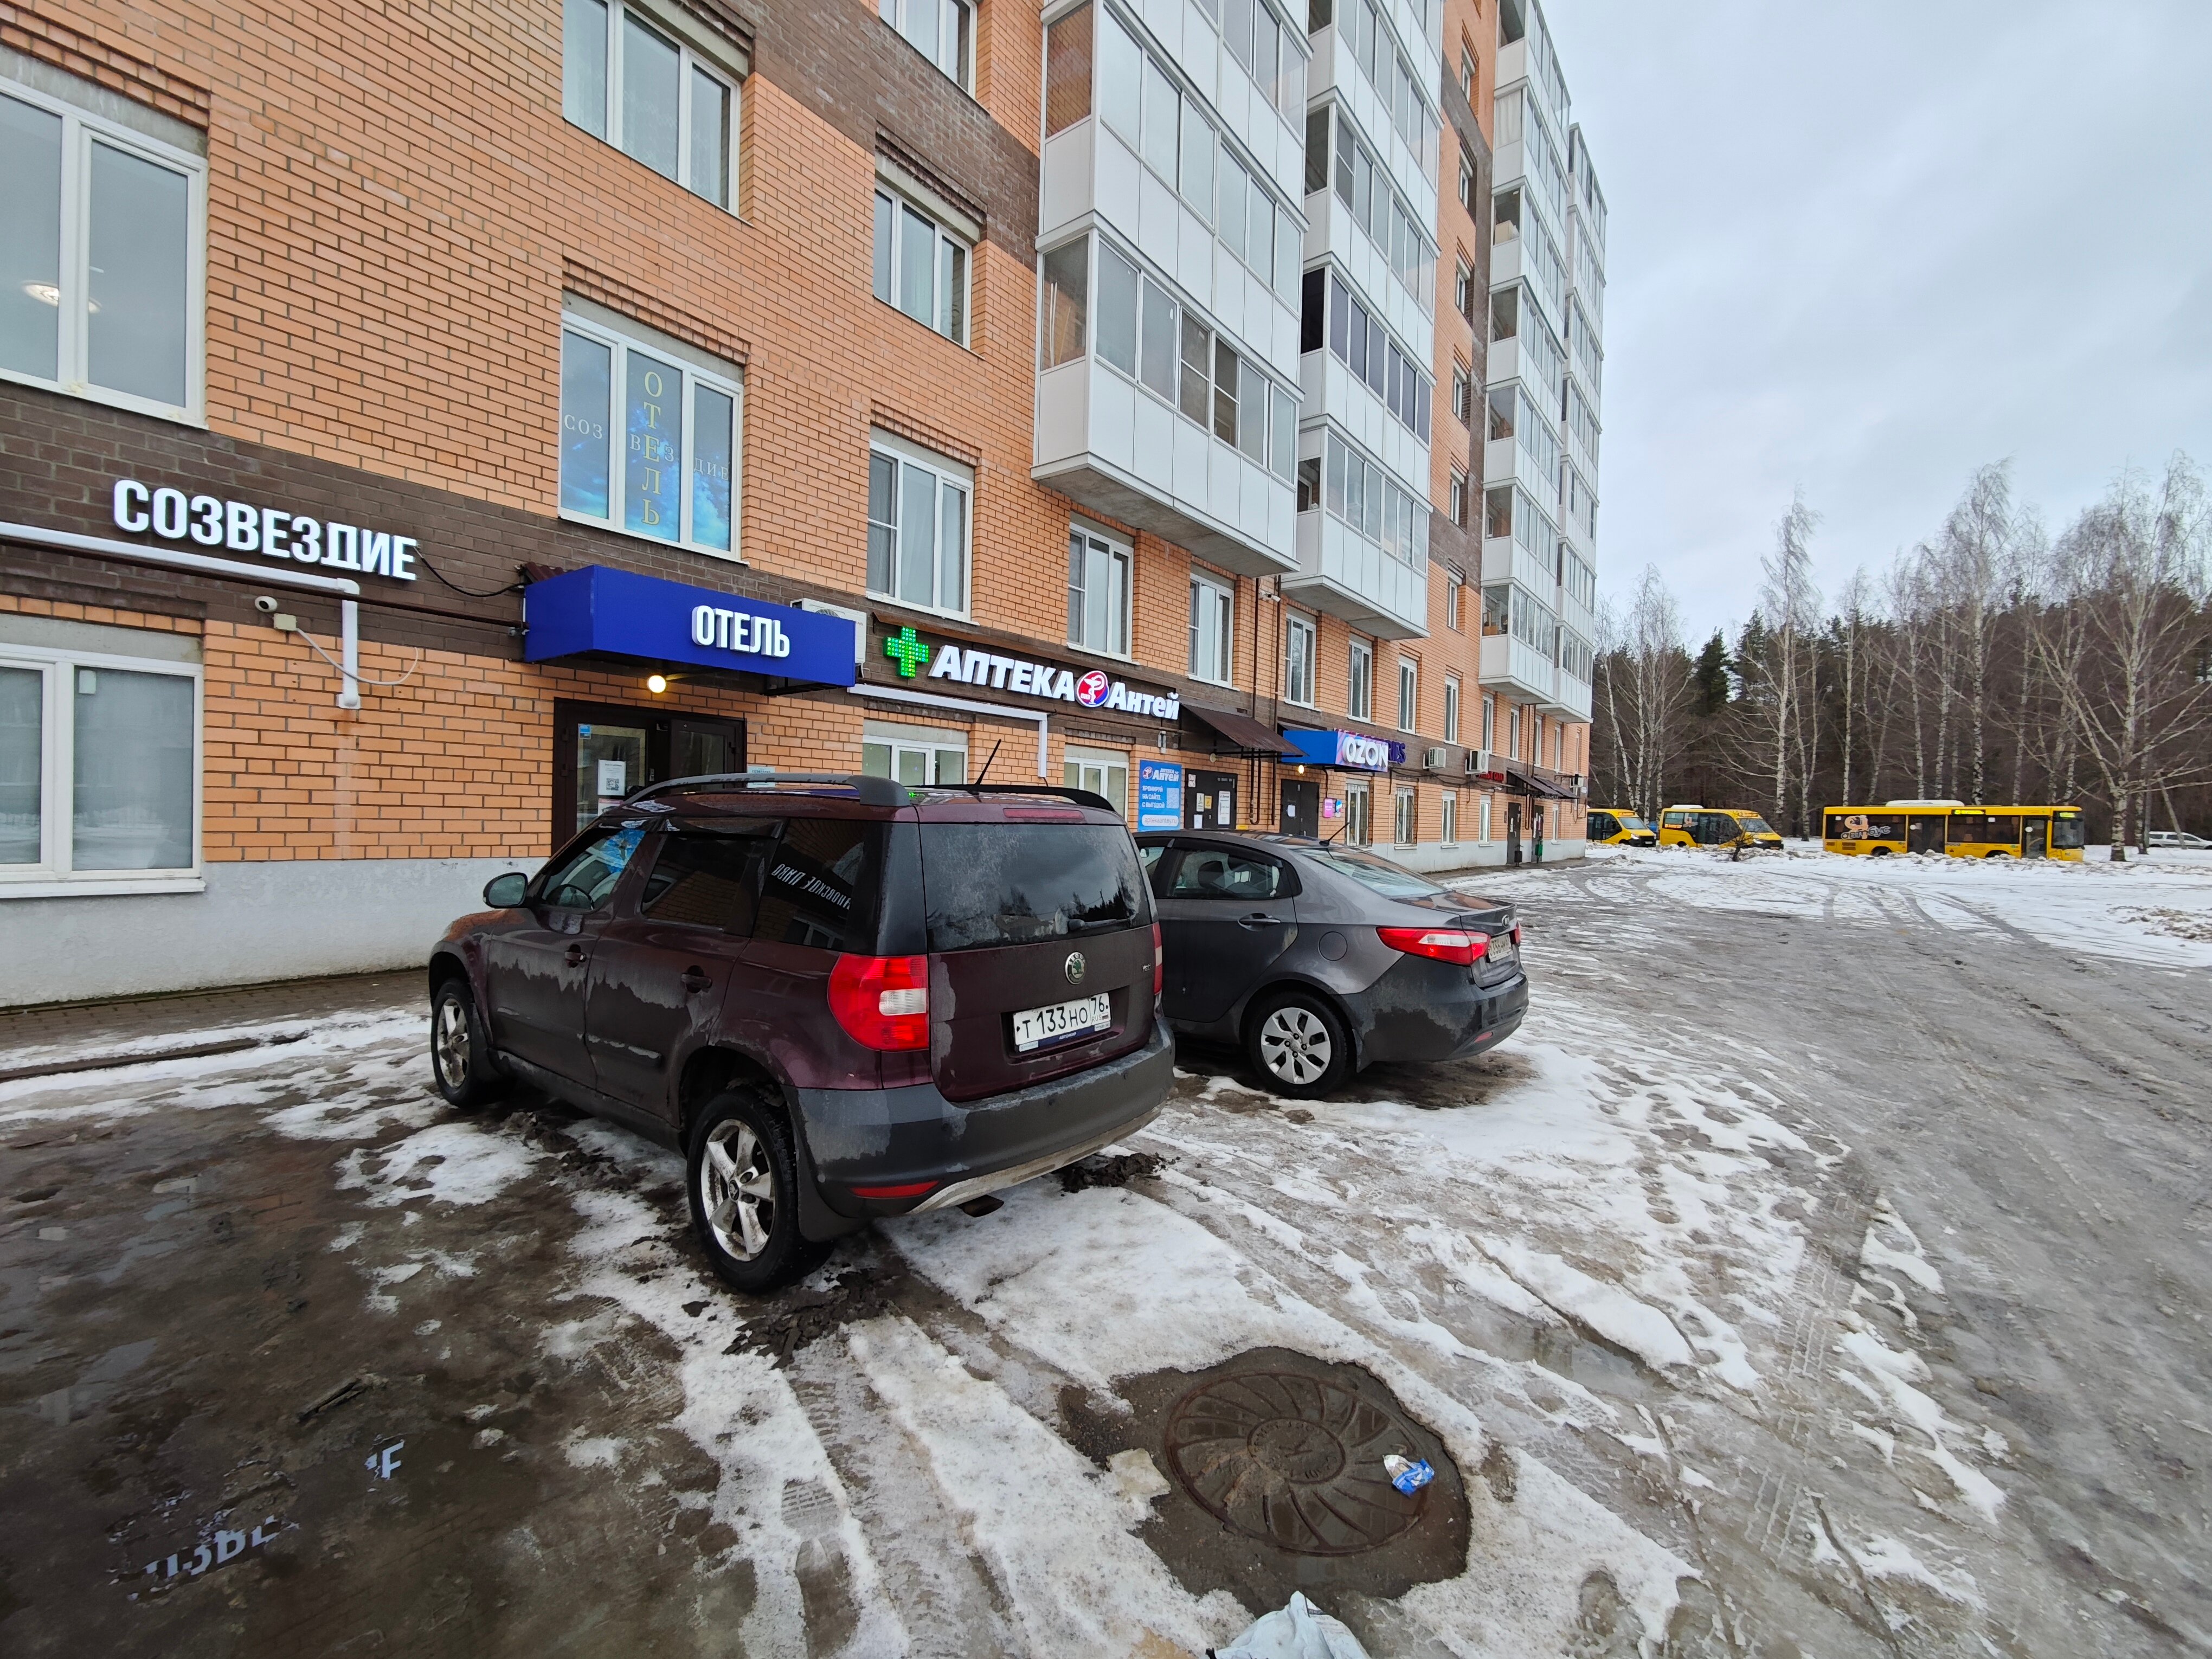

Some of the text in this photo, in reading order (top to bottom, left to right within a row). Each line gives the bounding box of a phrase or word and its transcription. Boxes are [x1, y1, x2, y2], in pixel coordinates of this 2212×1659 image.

[642, 371, 663, 526] ОТЕЛЬ
[113, 479, 419, 582] СОЗВЕЗДИЕ
[691, 605, 790, 658] ОТЕЛЬ
[928, 644, 1180, 720] АПТЕКА Антей
[1342, 736, 1389, 768] OZON
[1152, 769, 1179, 782] Антей
[1144, 816, 1177, 825] aptekaantey.ru
[1091, 1014, 1102, 1023] RUS
